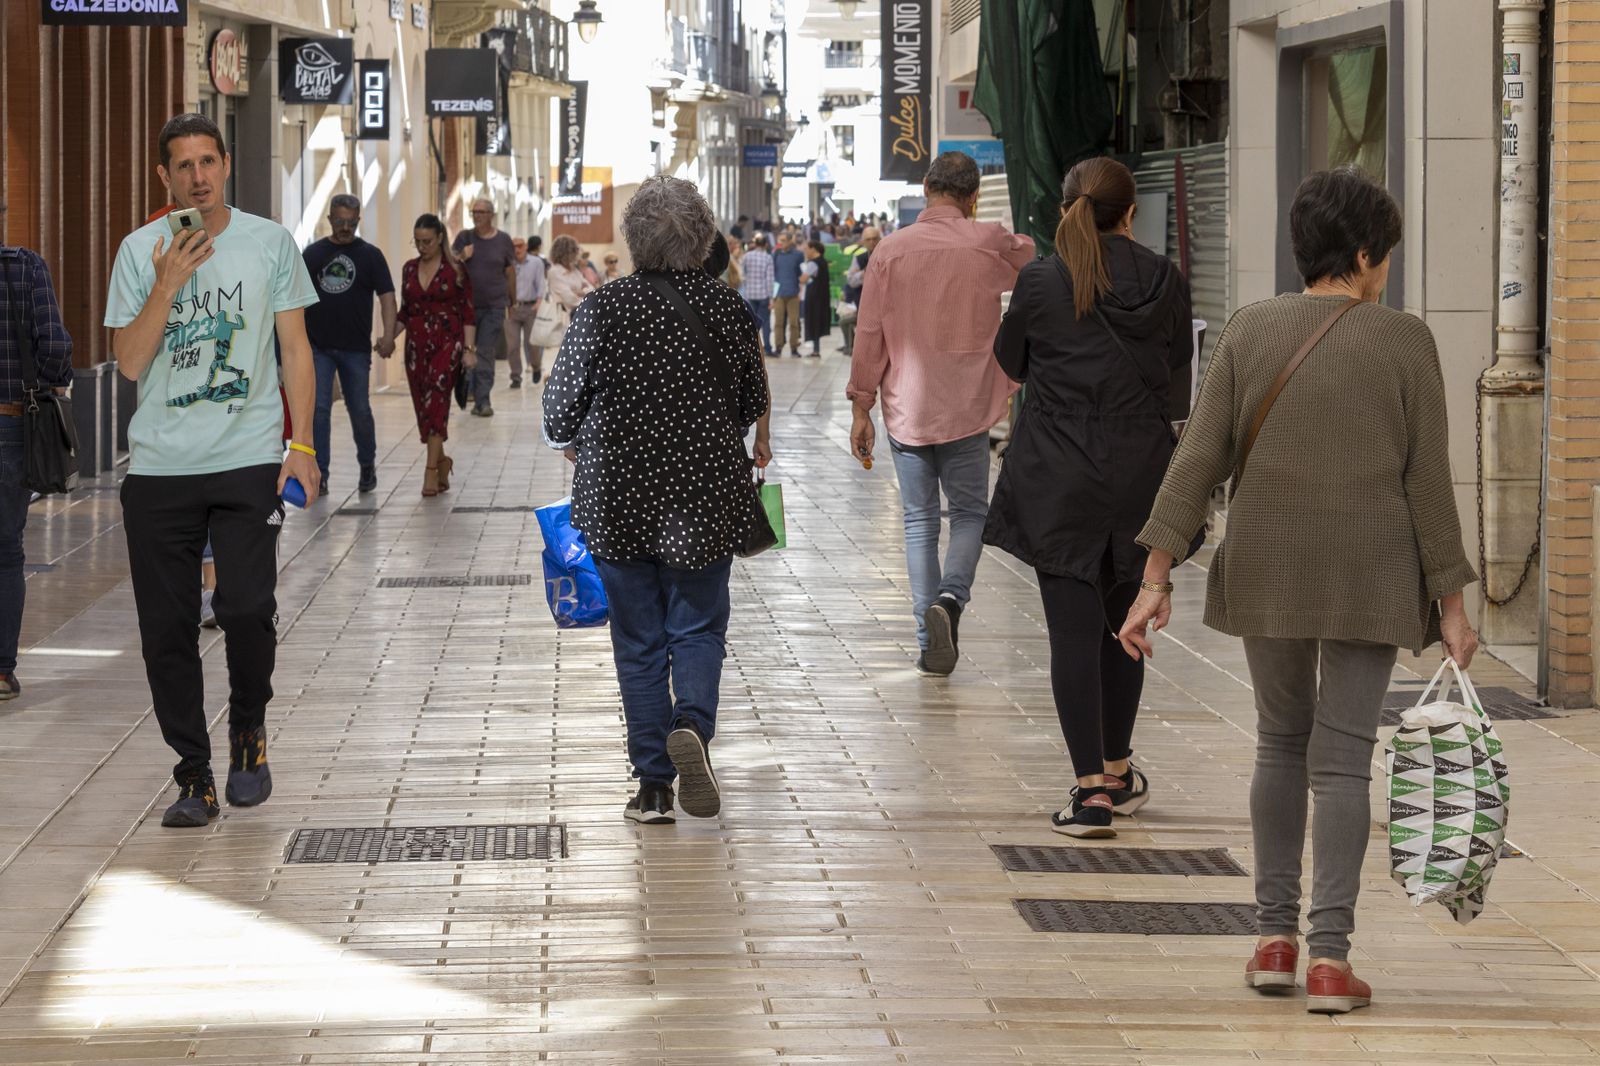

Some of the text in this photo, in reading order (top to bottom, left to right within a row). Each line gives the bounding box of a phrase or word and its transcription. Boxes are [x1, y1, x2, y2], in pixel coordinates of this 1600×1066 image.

[50, 0, 180, 12] CALZEDONIA
[295, 63, 344, 88] BRUTAL
[889, 3, 924, 161] Dulce MOMENTO
